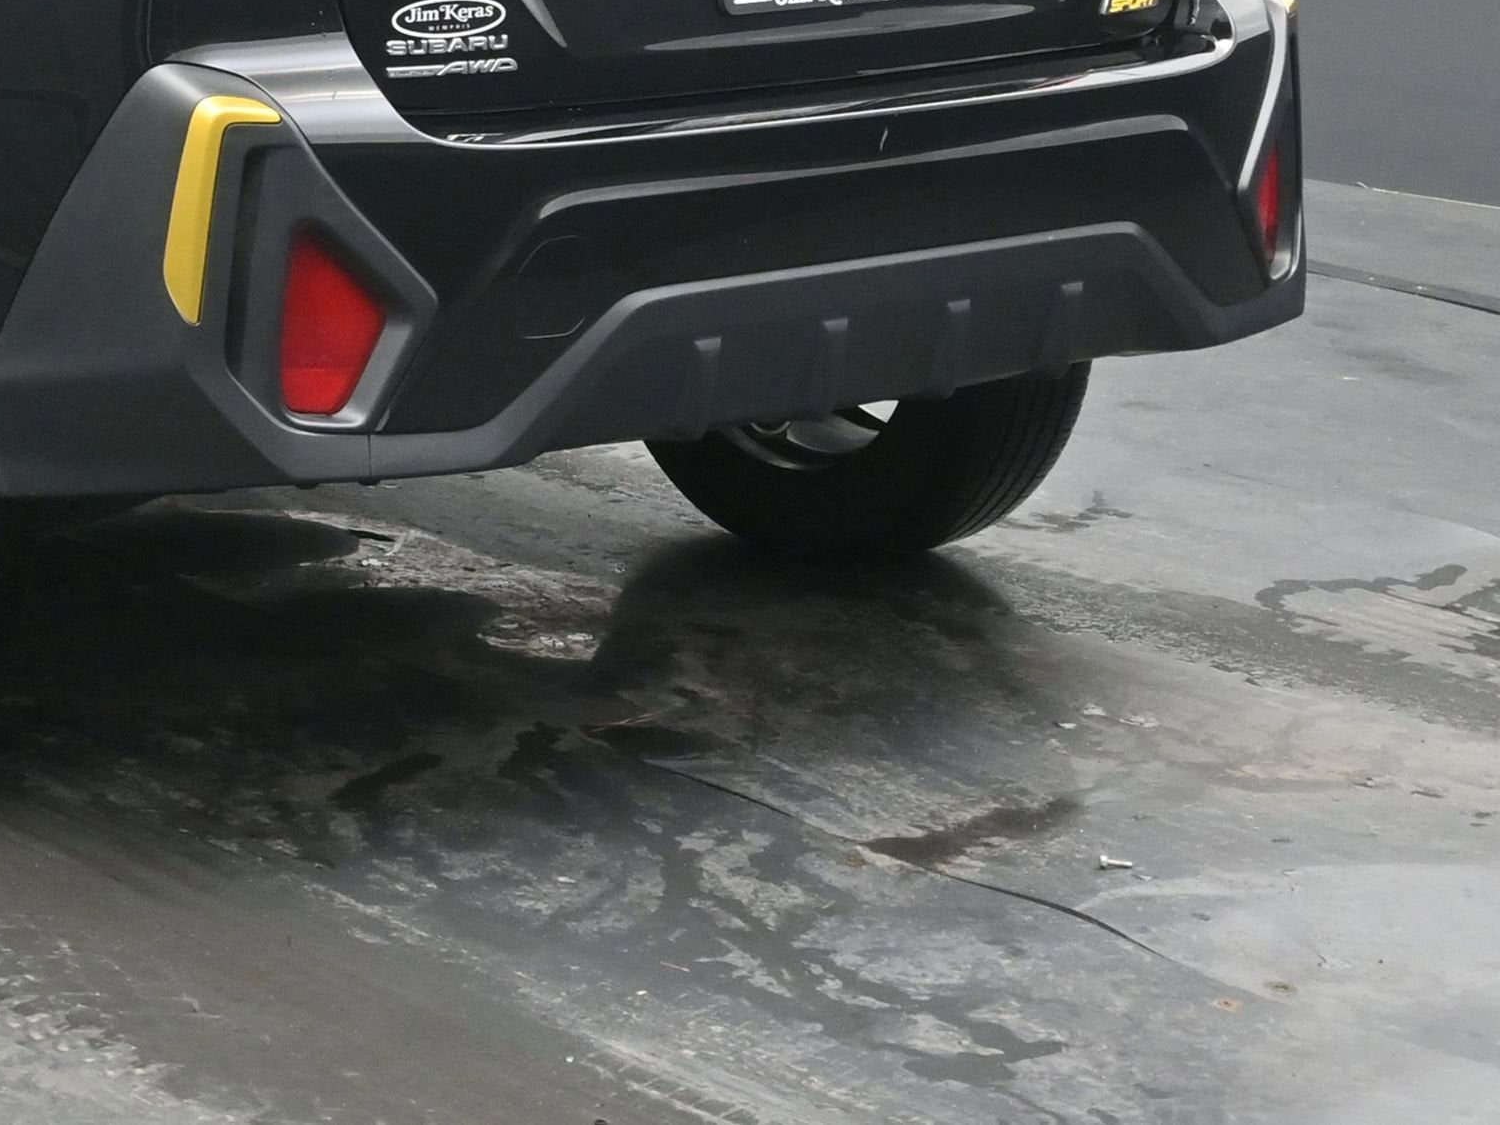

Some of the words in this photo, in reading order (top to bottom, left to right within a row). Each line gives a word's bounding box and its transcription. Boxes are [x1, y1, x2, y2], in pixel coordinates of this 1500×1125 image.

[404, 8, 440, 24] Jim
[439, 4, 494, 23] Keras
[386, 34, 508, 56] SUBARU
[437, 57, 518, 76] AWD
